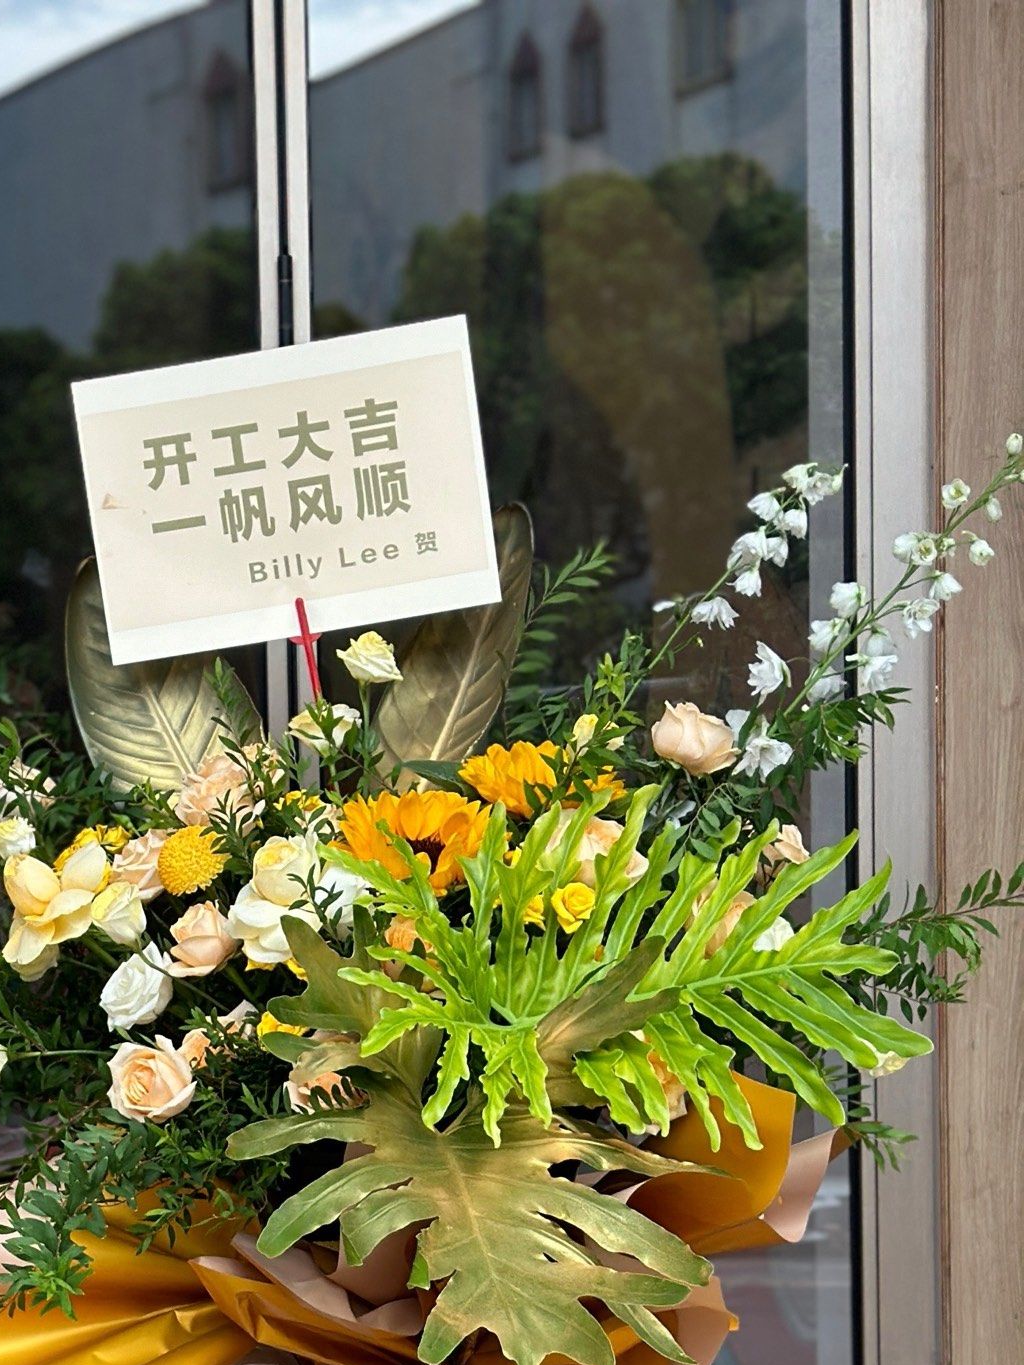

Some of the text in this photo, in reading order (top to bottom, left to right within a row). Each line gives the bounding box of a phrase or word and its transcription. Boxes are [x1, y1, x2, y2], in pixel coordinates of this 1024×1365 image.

[143, 398, 399, 491] 开工大吉
[151, 460, 412, 544] 一帆风顺
[248, 531, 438, 584] Billy Lee 贺
